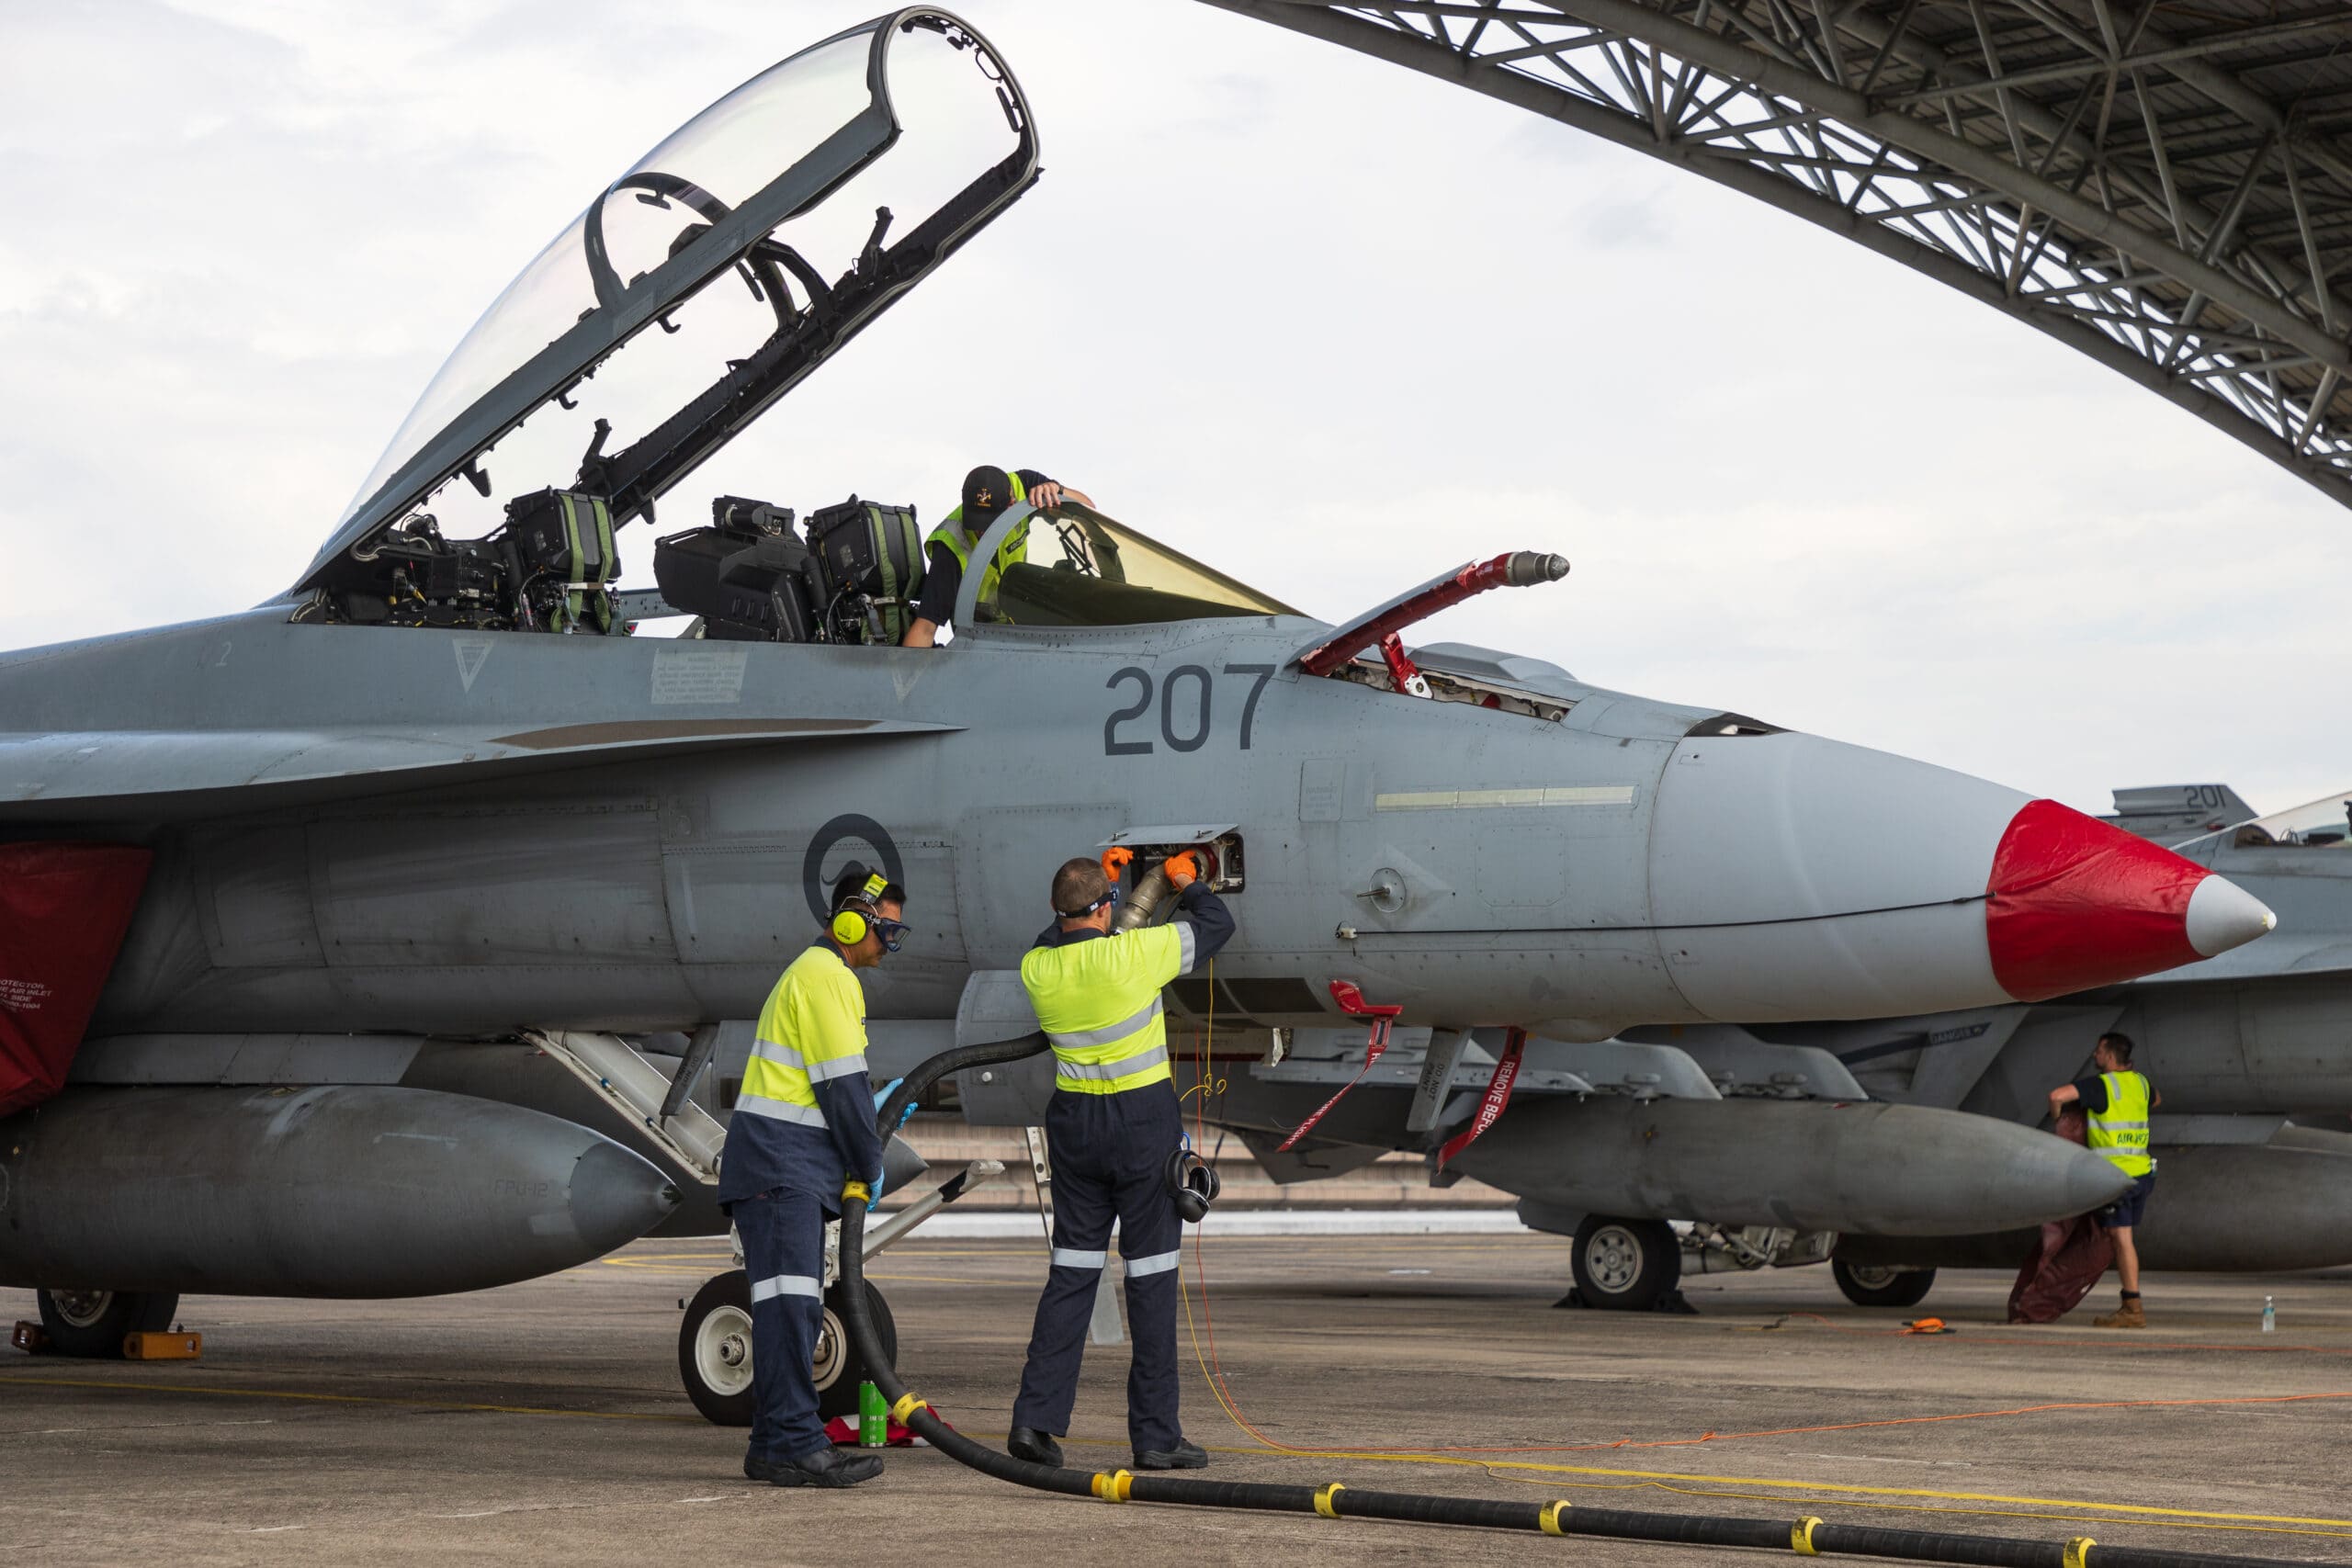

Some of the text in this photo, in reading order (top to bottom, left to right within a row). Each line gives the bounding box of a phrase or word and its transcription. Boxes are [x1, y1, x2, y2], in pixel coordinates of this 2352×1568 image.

[1104, 664, 1277, 756] 207
[2183, 785, 2226, 808] 201
[0, 979, 45, 989] OTECTOR
[1421, 1062, 1436, 1092] PAINT
[1428, 1063, 1446, 1101] DO NOT
[1473, 1060, 1516, 1140] REMOVE BEFO
[1286, 1117, 1317, 1145] FLIGHT
[2117, 1132, 2133, 1145] AIR
